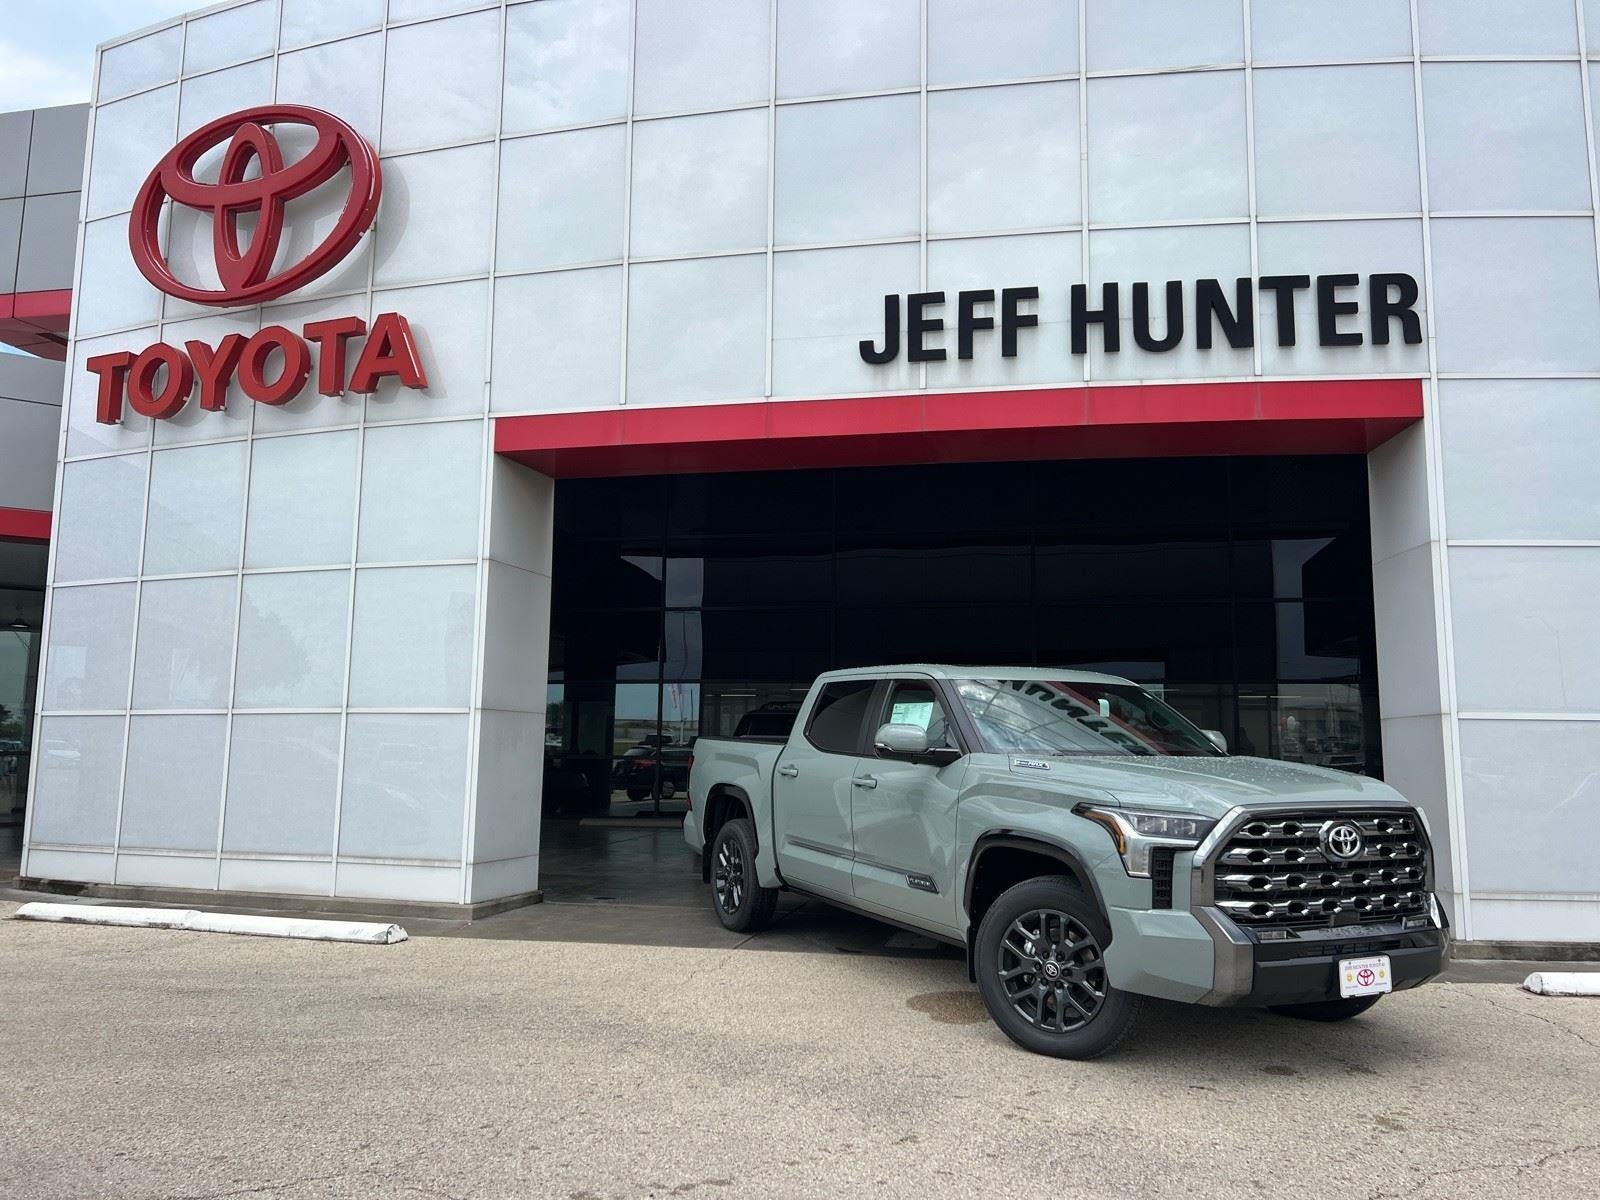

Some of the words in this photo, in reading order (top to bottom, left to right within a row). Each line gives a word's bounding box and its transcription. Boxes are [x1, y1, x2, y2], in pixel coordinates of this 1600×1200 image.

[87, 312, 428, 425] TOYOTA
[859, 286, 1039, 365] JEFF
[1070, 273, 1423, 355] HUNTER
